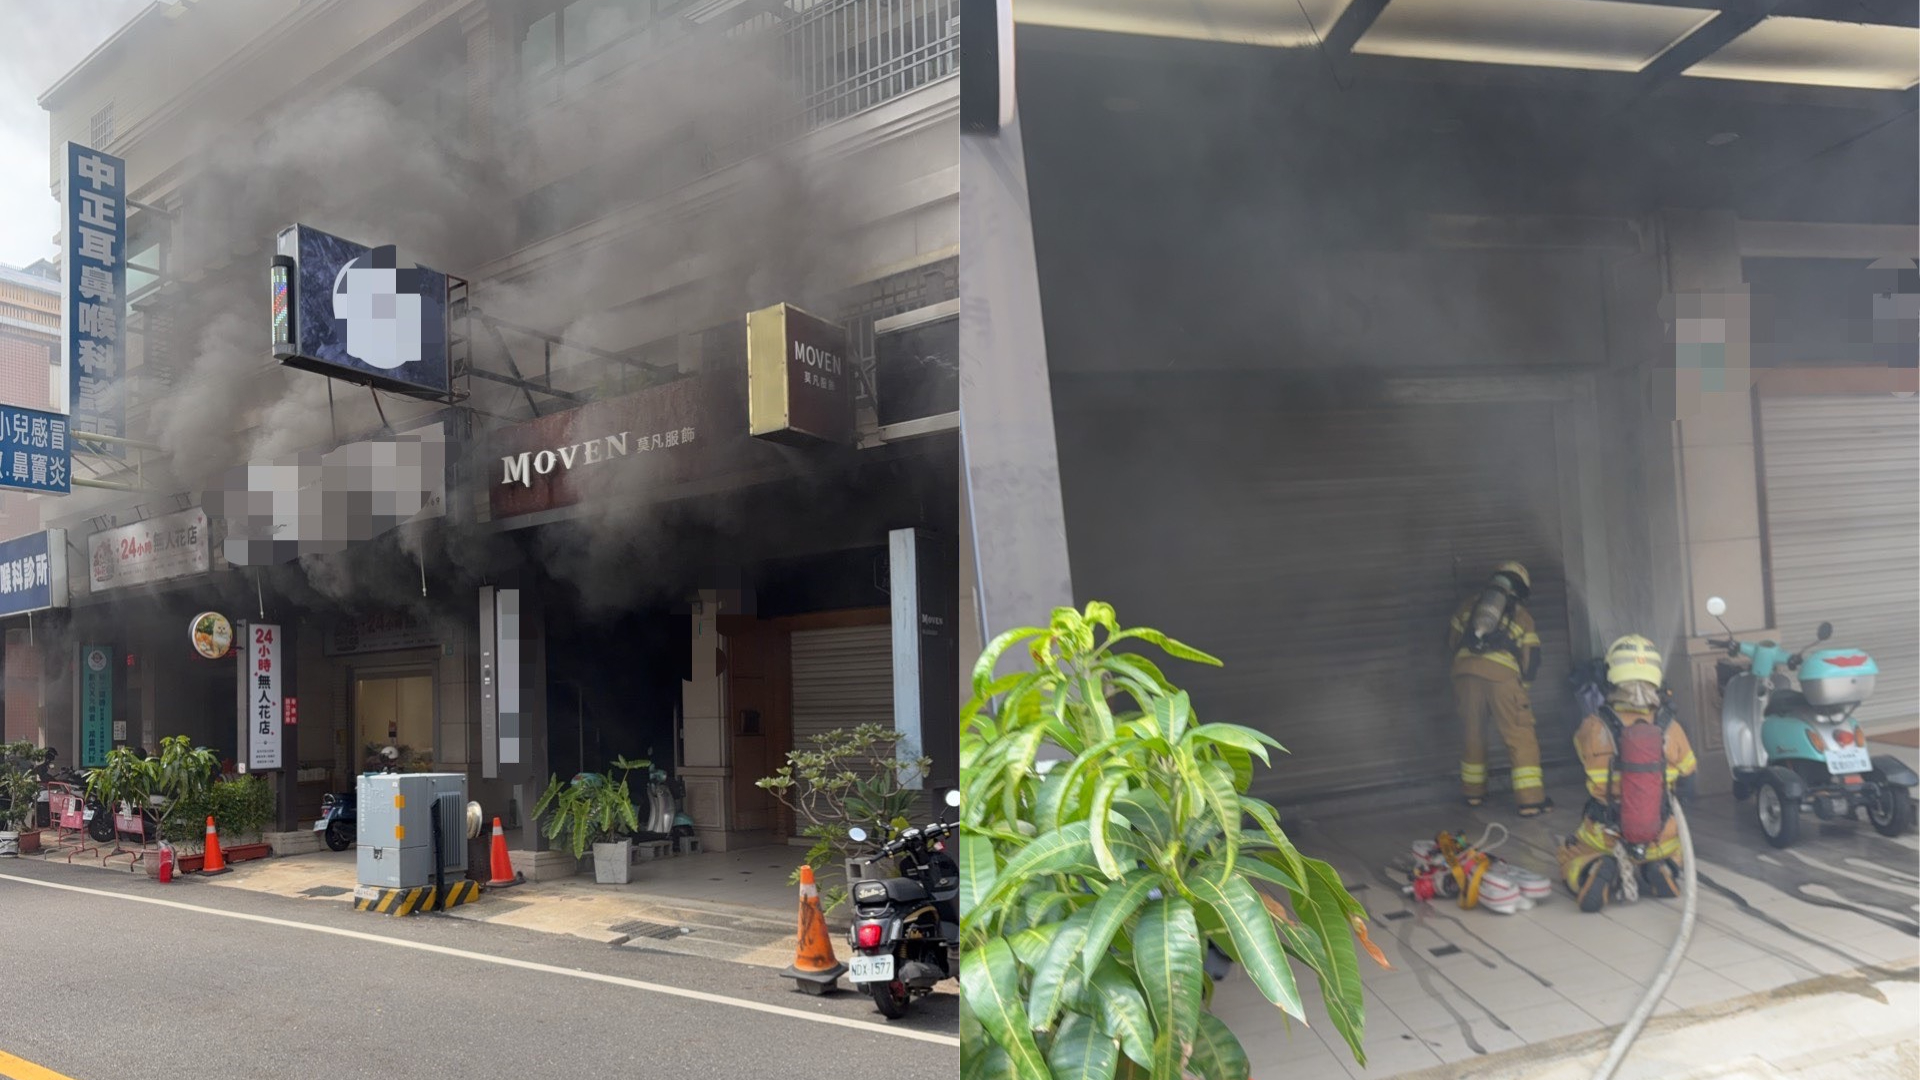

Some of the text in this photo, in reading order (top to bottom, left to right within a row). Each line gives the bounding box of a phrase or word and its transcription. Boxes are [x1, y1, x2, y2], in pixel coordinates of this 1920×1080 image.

[795, 340, 841, 375] MOVEN
[501, 431, 631, 488] MOVEN
[637, 426, 696, 453] 莫凡服飾
[255, 628, 274, 735] 24小時無人花店
